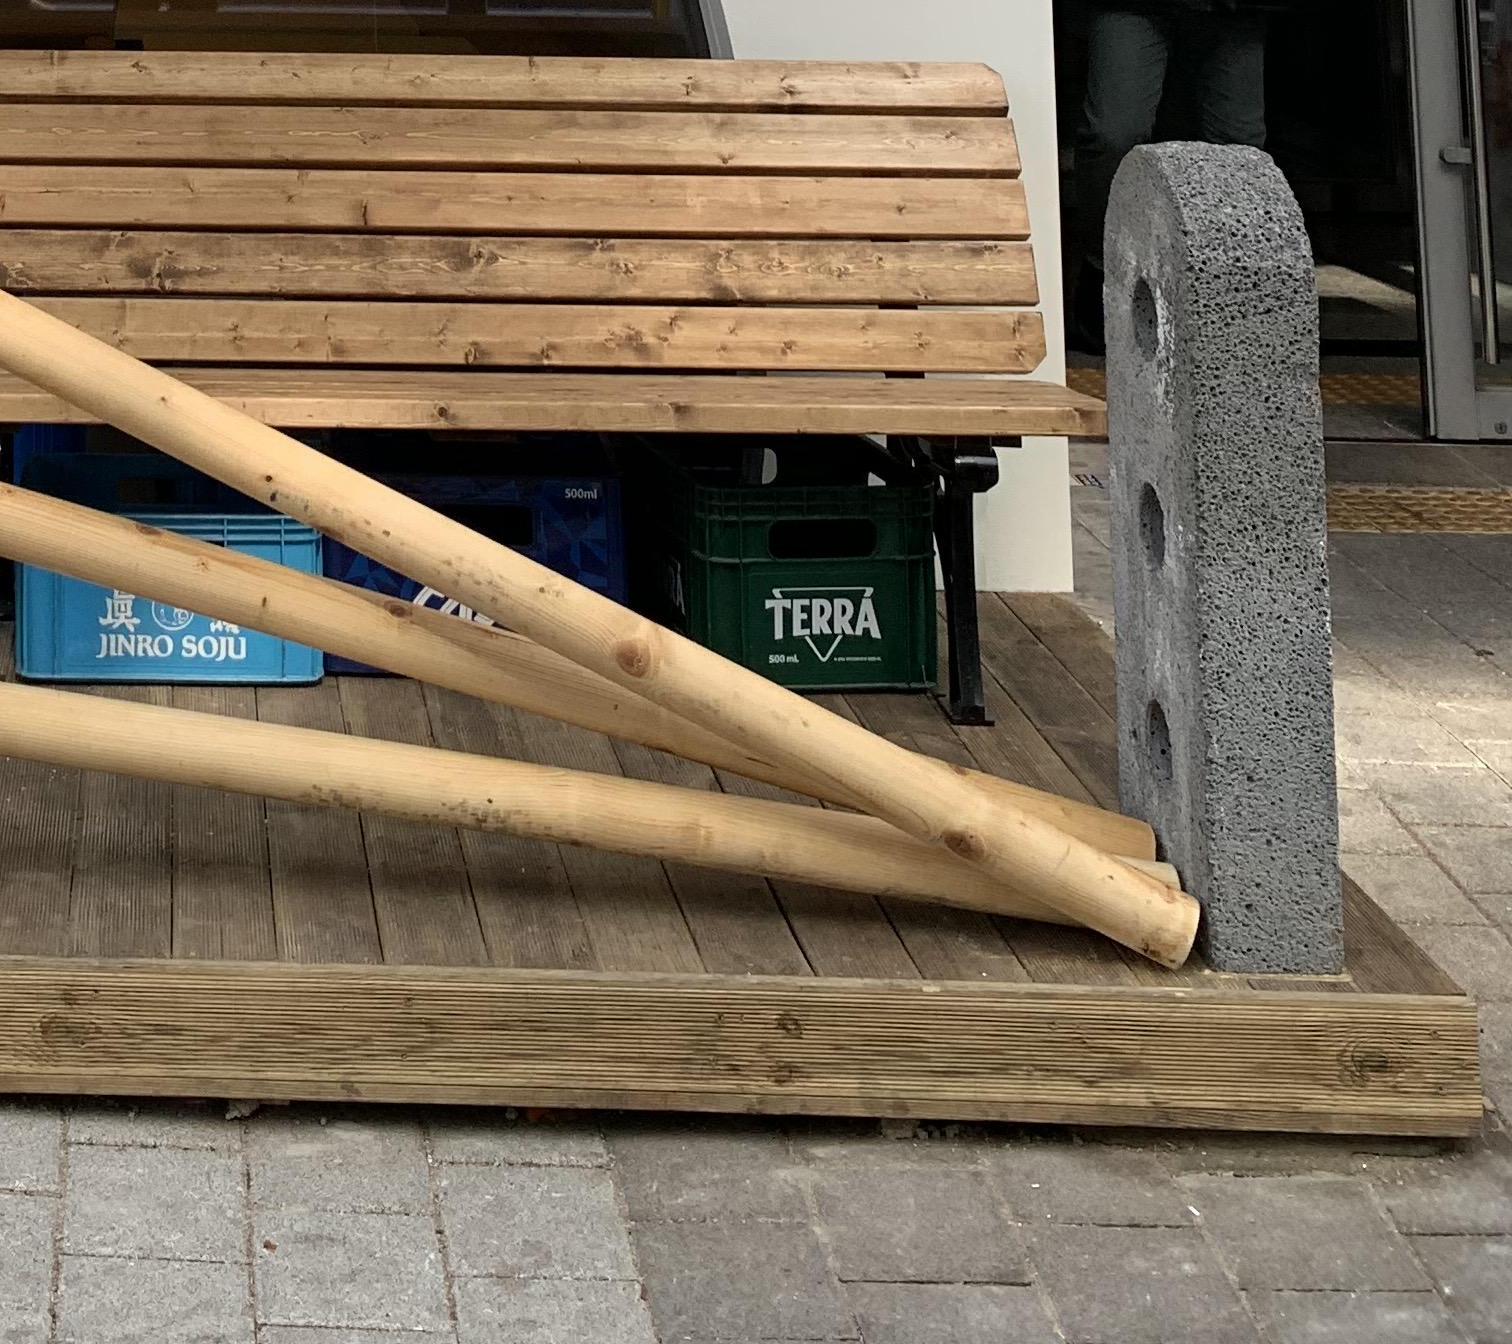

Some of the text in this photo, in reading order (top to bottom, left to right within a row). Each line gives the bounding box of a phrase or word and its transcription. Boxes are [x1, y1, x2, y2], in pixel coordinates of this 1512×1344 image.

[564, 487, 599, 500] 500ml
[765, 596, 882, 641] TERRA
[96, 632, 248, 661] JINRO SOJU
